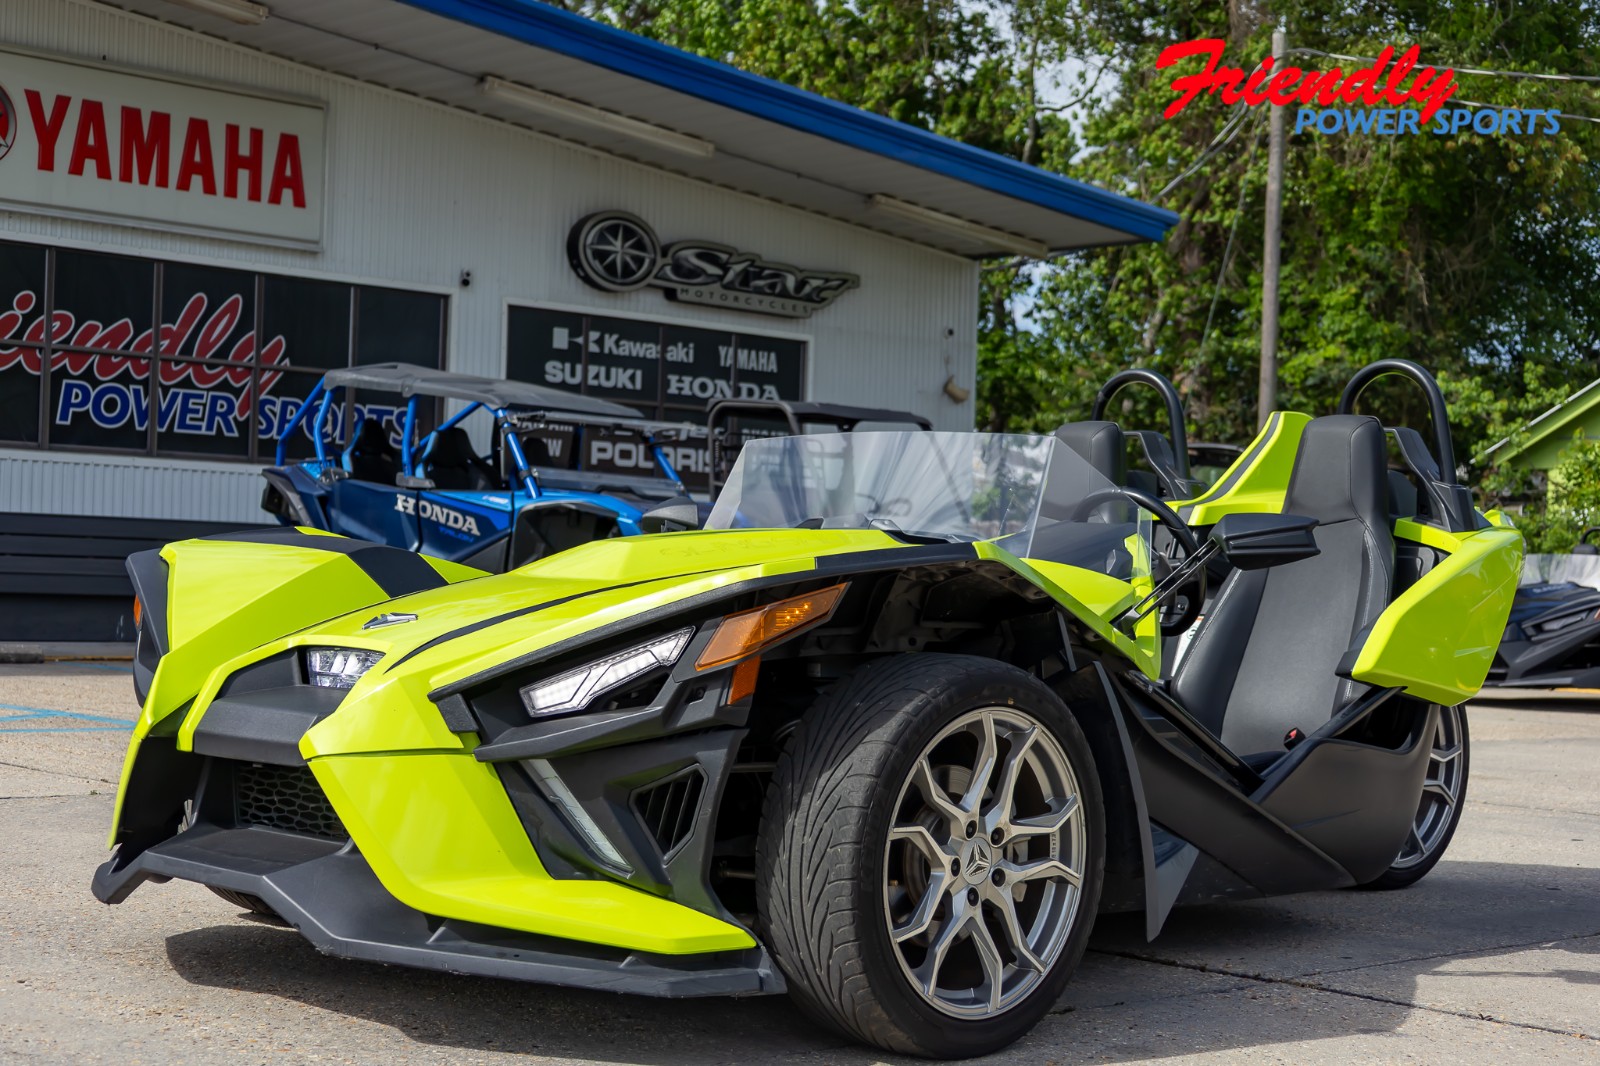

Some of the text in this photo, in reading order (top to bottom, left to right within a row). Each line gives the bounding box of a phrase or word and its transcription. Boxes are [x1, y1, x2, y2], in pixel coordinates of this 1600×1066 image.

[23, 88, 307, 209] YAMAHA
[652, 247, 850, 305] Star
[679, 286, 809, 315] MOTORCYCLES
[0, 290, 291, 421] iendly
[544, 360, 643, 391] SUZUKI
[718, 345, 778, 373] YAMAHA
[56, 379, 239, 438] POWER
[666, 374, 780, 401] HONDA
[394, 493, 481, 536] HONDA
